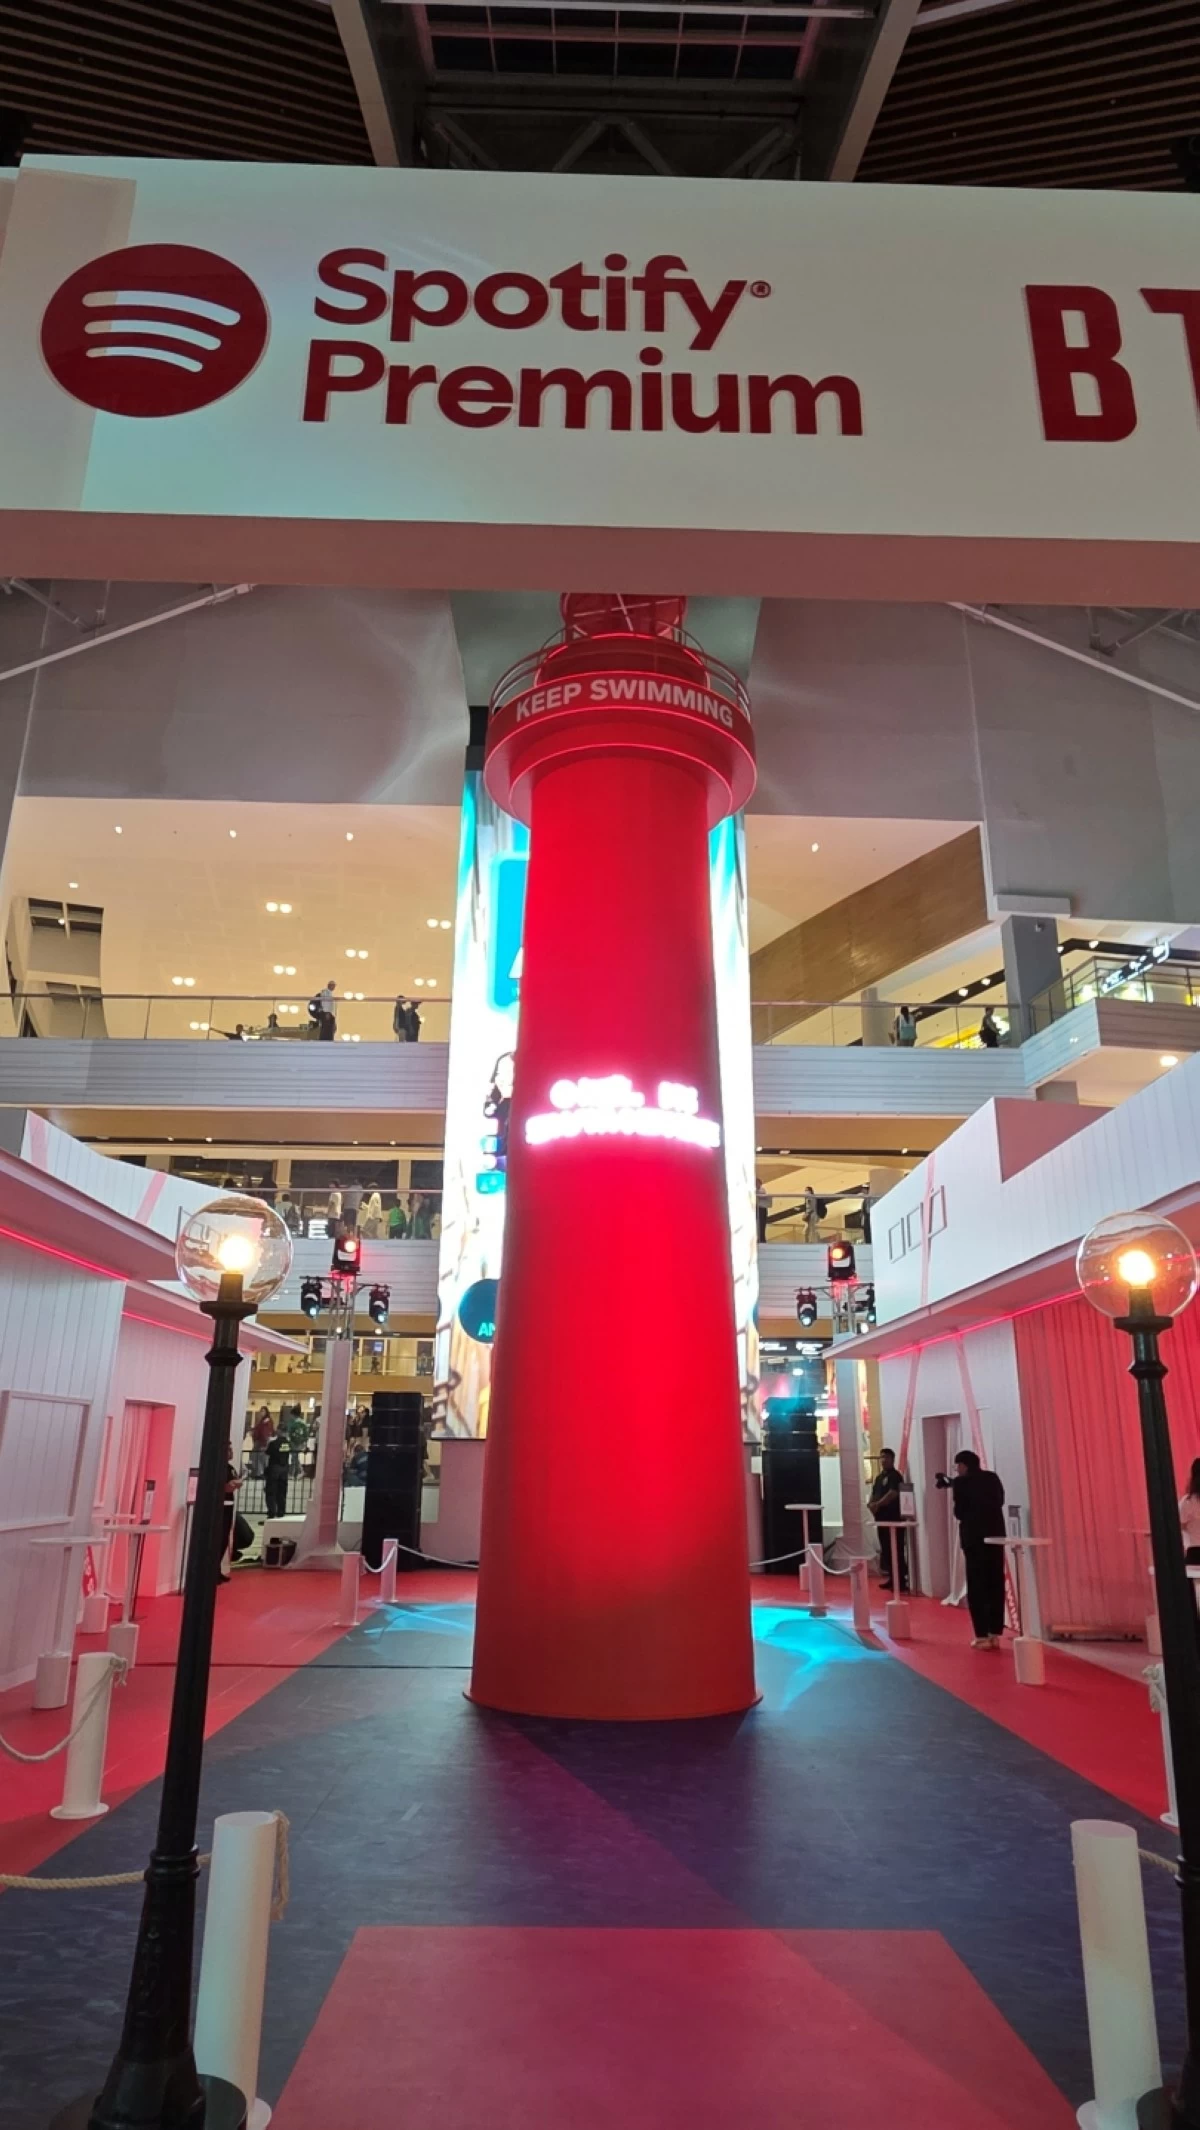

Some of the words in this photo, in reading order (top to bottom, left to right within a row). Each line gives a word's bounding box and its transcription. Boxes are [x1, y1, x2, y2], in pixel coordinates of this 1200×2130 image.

[303, 339, 863, 436] Premium
[516, 682, 582, 723] KEEP
[590, 679, 733, 729] SWIMMING
